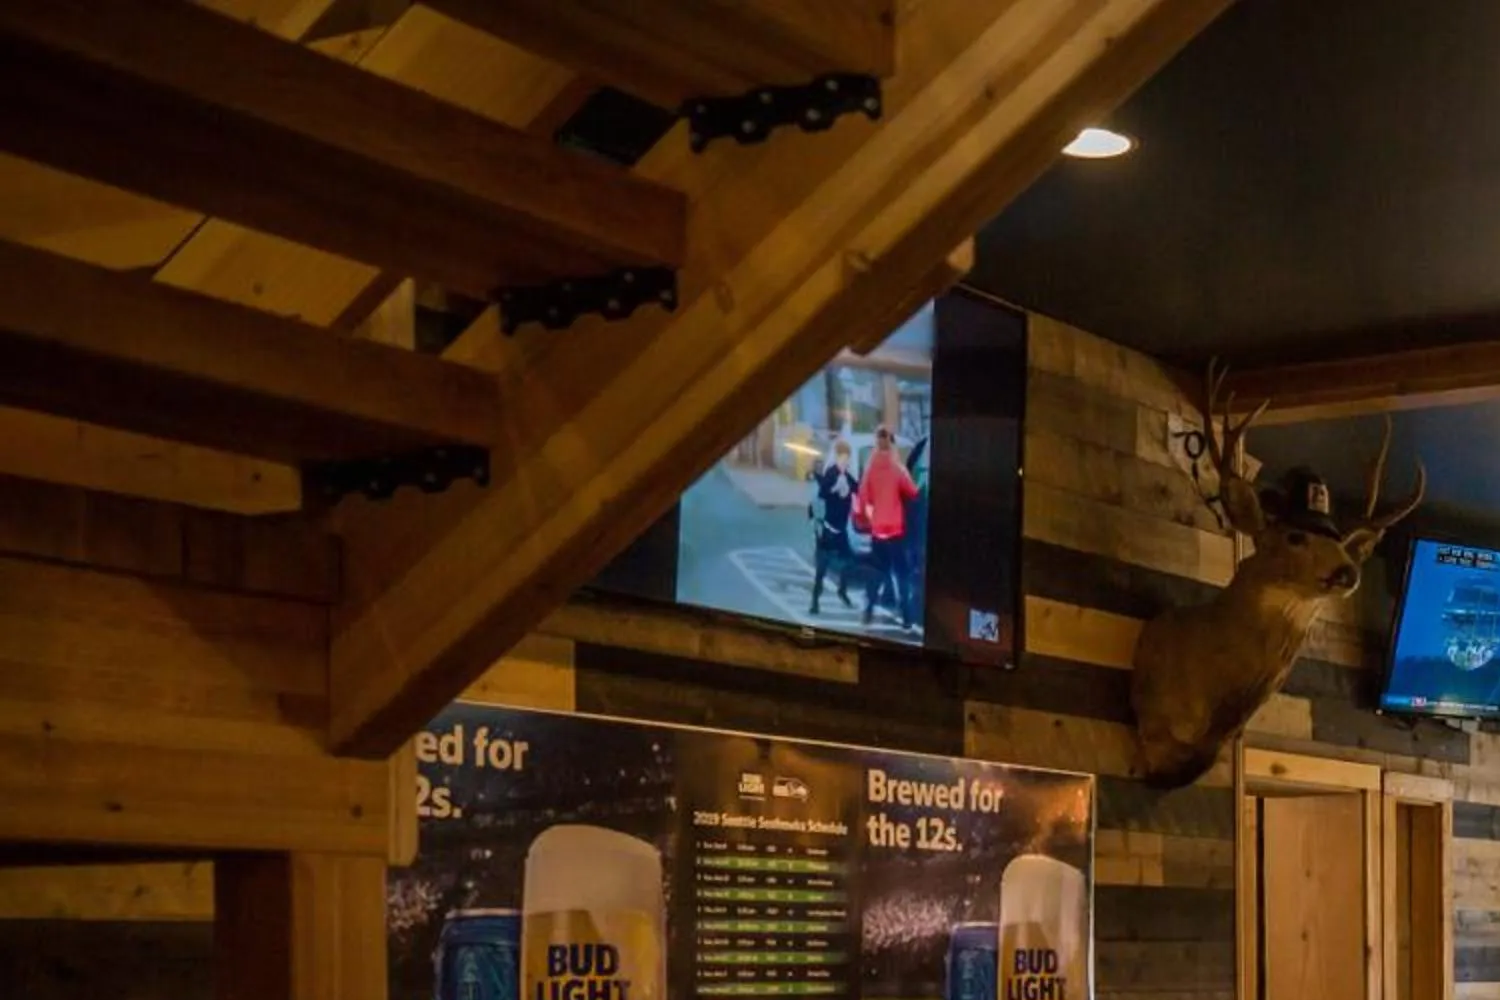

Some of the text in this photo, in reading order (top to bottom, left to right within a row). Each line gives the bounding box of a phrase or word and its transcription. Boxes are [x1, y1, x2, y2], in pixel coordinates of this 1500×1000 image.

[474, 725, 529, 771] for
[416, 776, 462, 819] 2s.
[868, 769, 1004, 813] Brewed for
[866, 813, 963, 852] the 12s.
[548, 943, 620, 977] BUD
[1014, 949, 1058, 975] BUD
